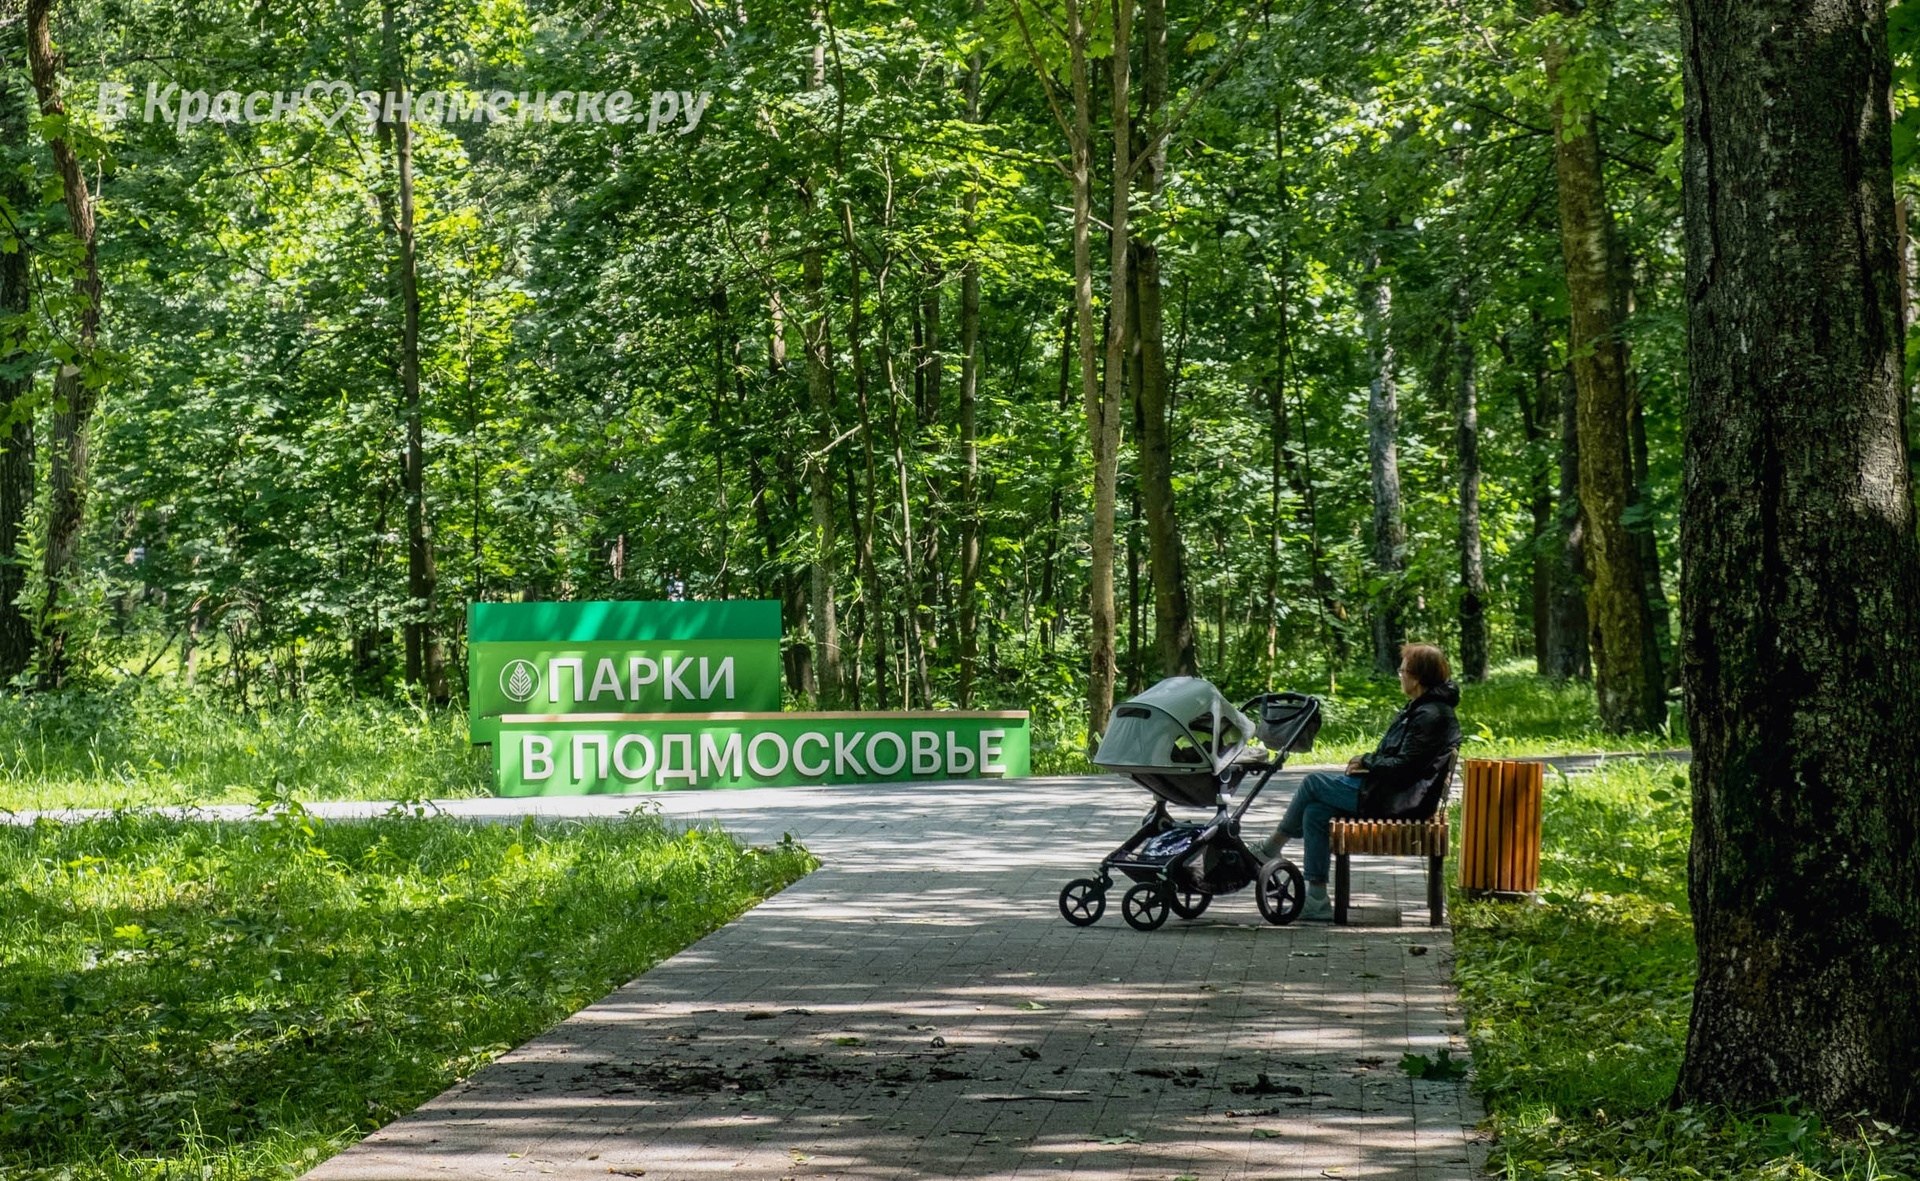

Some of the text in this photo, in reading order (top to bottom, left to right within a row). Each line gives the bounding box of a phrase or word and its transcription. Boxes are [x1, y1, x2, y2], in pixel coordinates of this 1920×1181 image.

[547, 656, 736, 702] ПАРКИ
[523, 730, 1006, 785] В ПОДМОСКОВЬЕ
